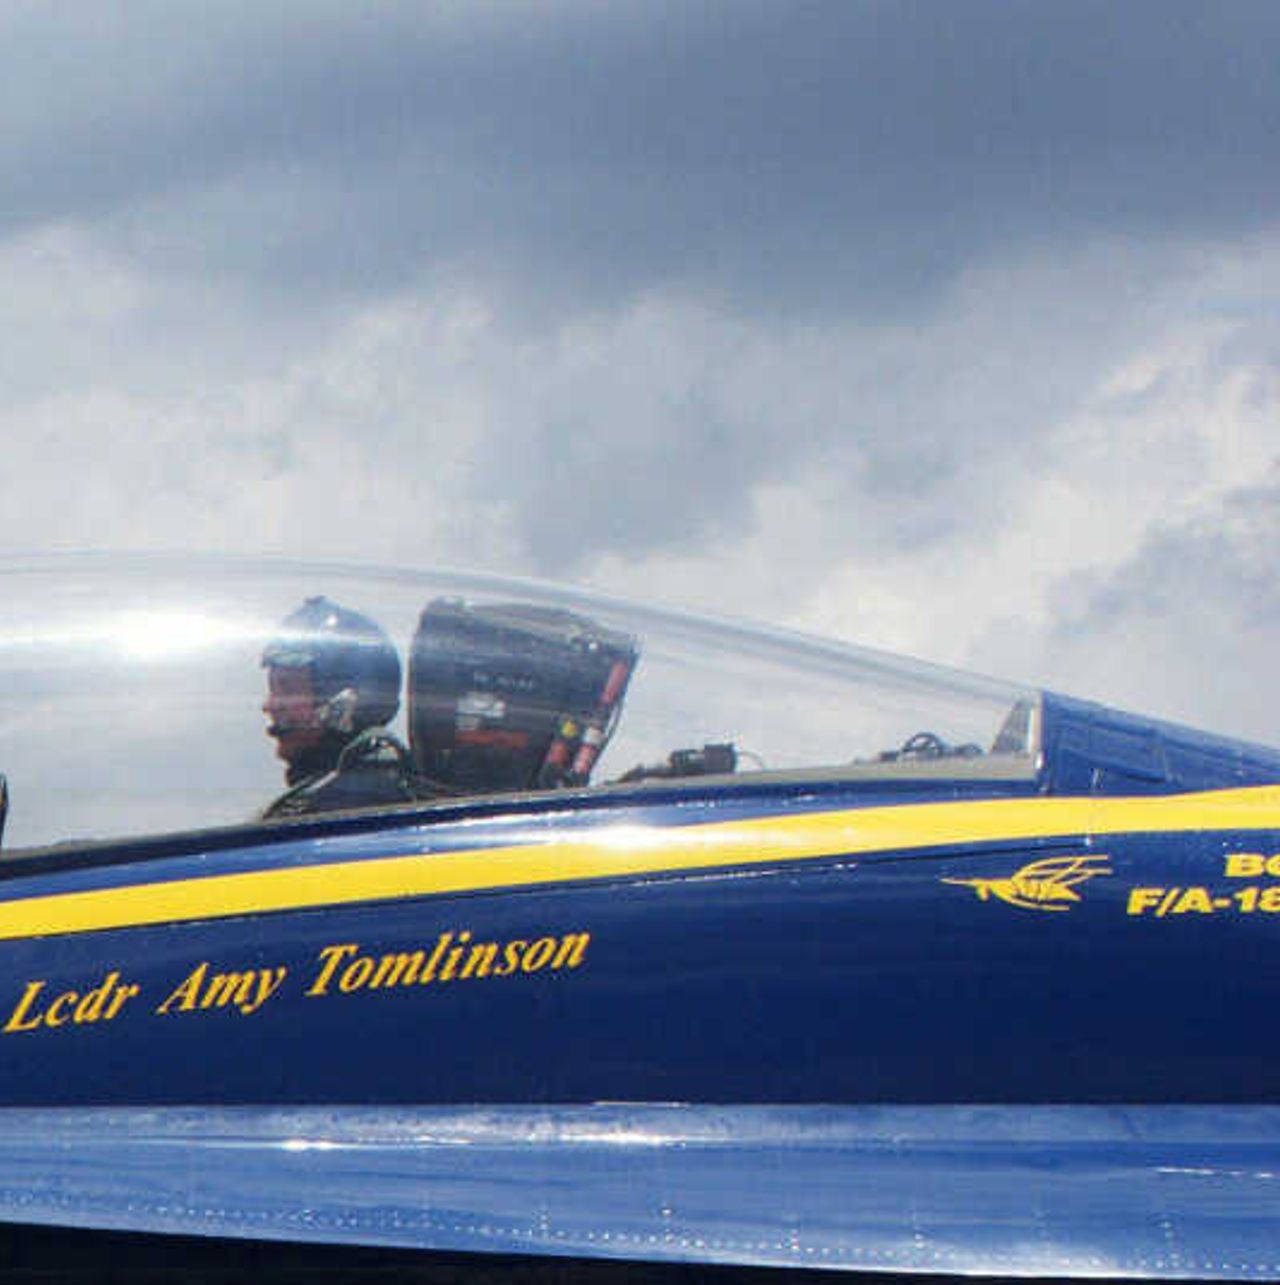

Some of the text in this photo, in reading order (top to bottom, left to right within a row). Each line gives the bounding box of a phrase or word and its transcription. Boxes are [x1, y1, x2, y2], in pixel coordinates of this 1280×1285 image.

[3, 931, 590, 1033] Lcdr Amy Tomlinson
